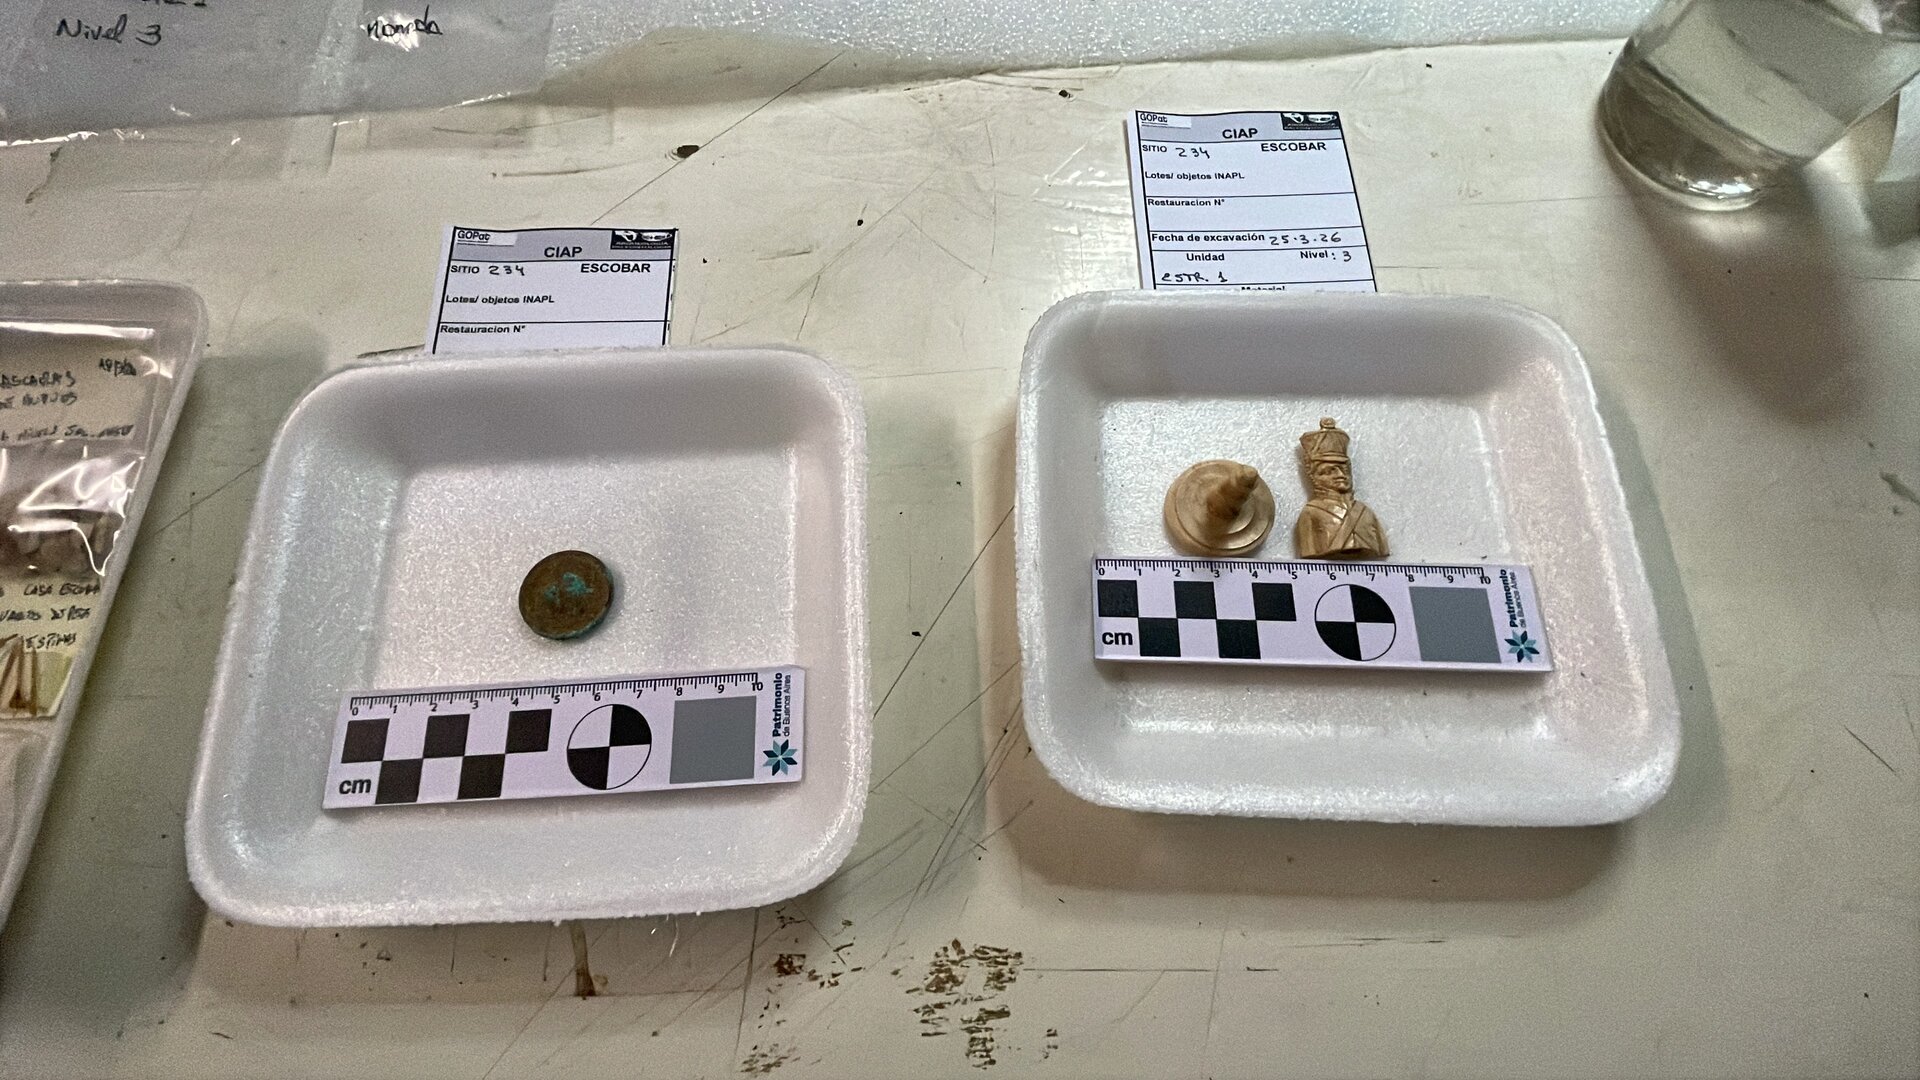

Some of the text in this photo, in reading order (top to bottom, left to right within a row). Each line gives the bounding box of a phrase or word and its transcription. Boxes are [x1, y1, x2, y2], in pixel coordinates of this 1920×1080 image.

[56, 14, 162, 46] Nivel 3
[1222, 128, 1258, 139] CIAP
[1142, 144, 1211, 159] SITIO 234
[1261, 142, 1327, 152] ESCOBAR
[1145, 171, 1174, 179] Lotes/
[1176, 172, 1212, 181] objetos
[457, 230, 491, 241] GOPat
[1152, 233, 1184, 241] Fecha
[1187, 233, 1200, 241] de
[1203, 233, 1265, 241] excavación
[544, 247, 583, 258] CIAP
[1186, 253, 1225, 261] Unidad
[1342, 250, 1352, 262] 3
[450, 265, 525, 276] SITIO 234
[580, 263, 651, 273] ESCOBAR
[1218, 271, 1228, 282] 1
[446, 295, 555, 305] Lotes/ objetos INAPL
[440, 325, 510, 333] Restauracion
[1099, 568, 1491, 585] 0 1 2 3 4 5 6 7 8 9 10
[1499, 569, 1518, 627] Patrimonio
[1102, 632, 1133, 645] cm
[352, 682, 763, 715] 0 1 2 3 4 5 6 7 8 9 10
[772, 672, 782, 737] Patrimonio
[783, 696, 791, 725] Buenos
[339, 778, 372, 794] cm
